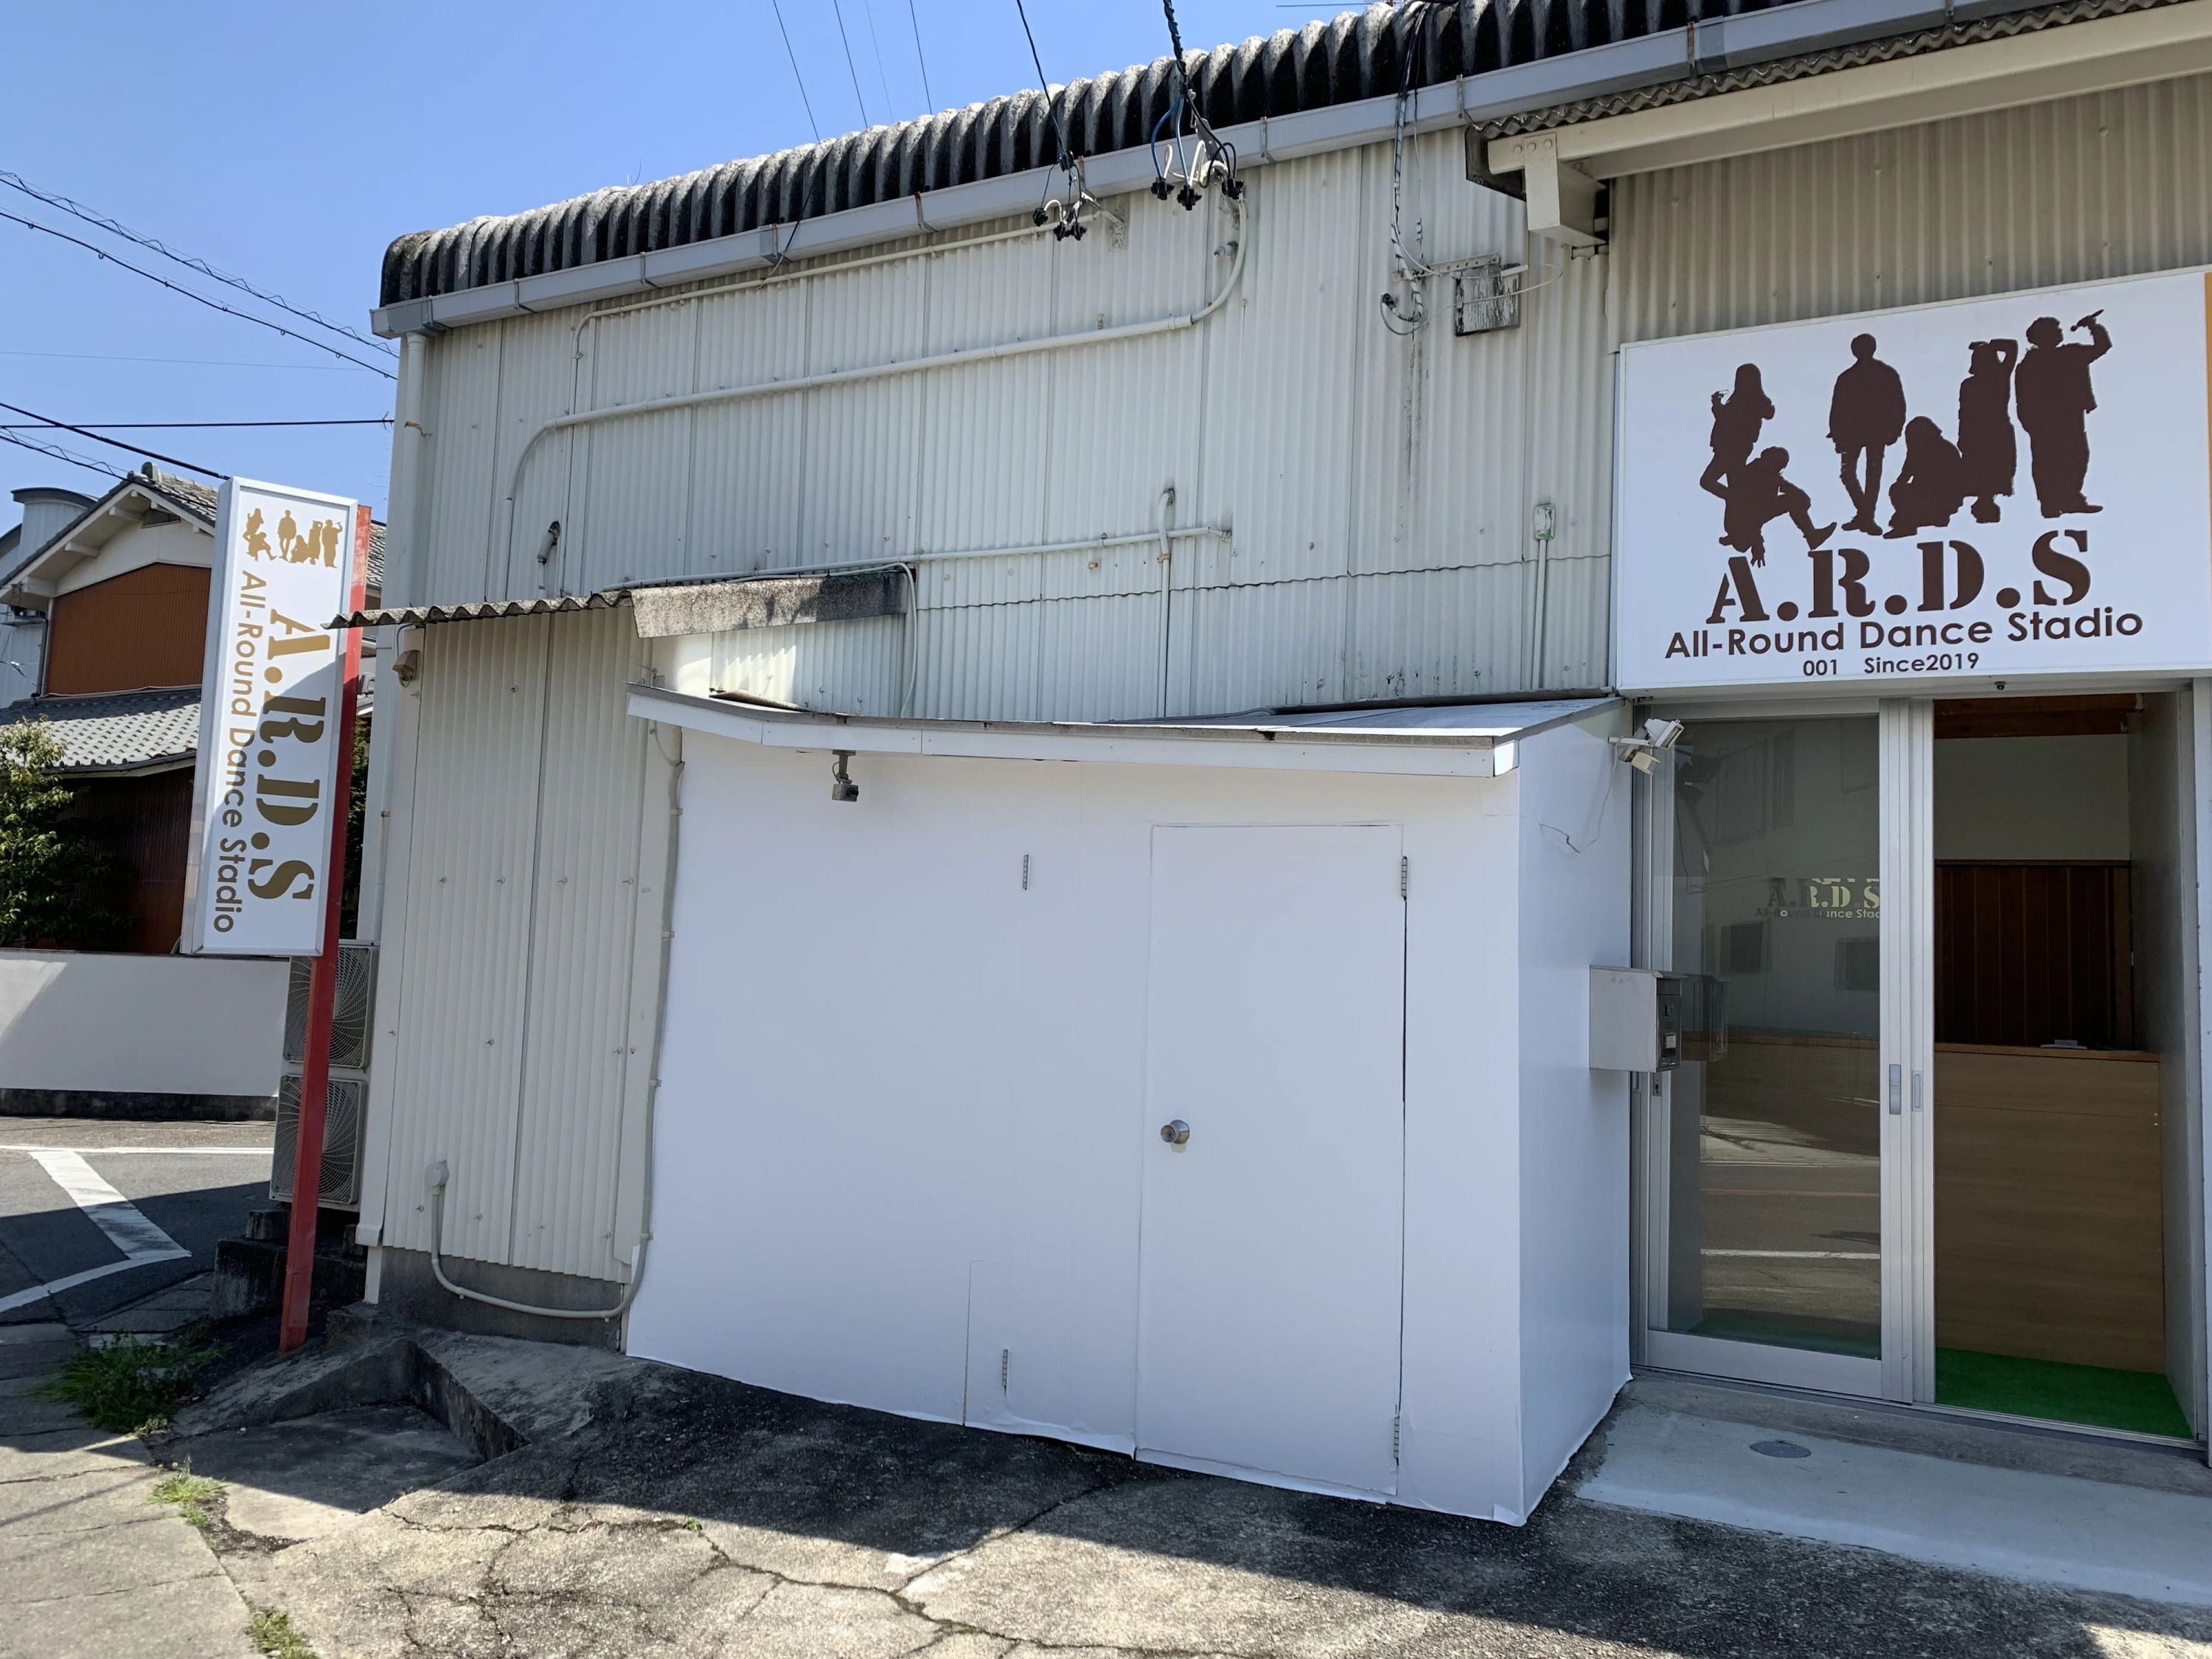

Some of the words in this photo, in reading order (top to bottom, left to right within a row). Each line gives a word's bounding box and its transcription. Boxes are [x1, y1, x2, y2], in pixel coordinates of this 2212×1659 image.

[1705, 529, 2091, 625] A.R.D.S
[231, 570, 266, 717] All-Round
[1664, 622, 1845, 659] All-Round
[1860, 622, 1994, 649] Dance
[2007, 606, 2143, 642] Stadio
[1803, 659, 1837, 677] 001
[1864, 653, 1979, 674] Since2019
[223, 726, 255, 827] Dance
[247, 608, 330, 900] A.R.D.S
[213, 838, 247, 933] Stadio
